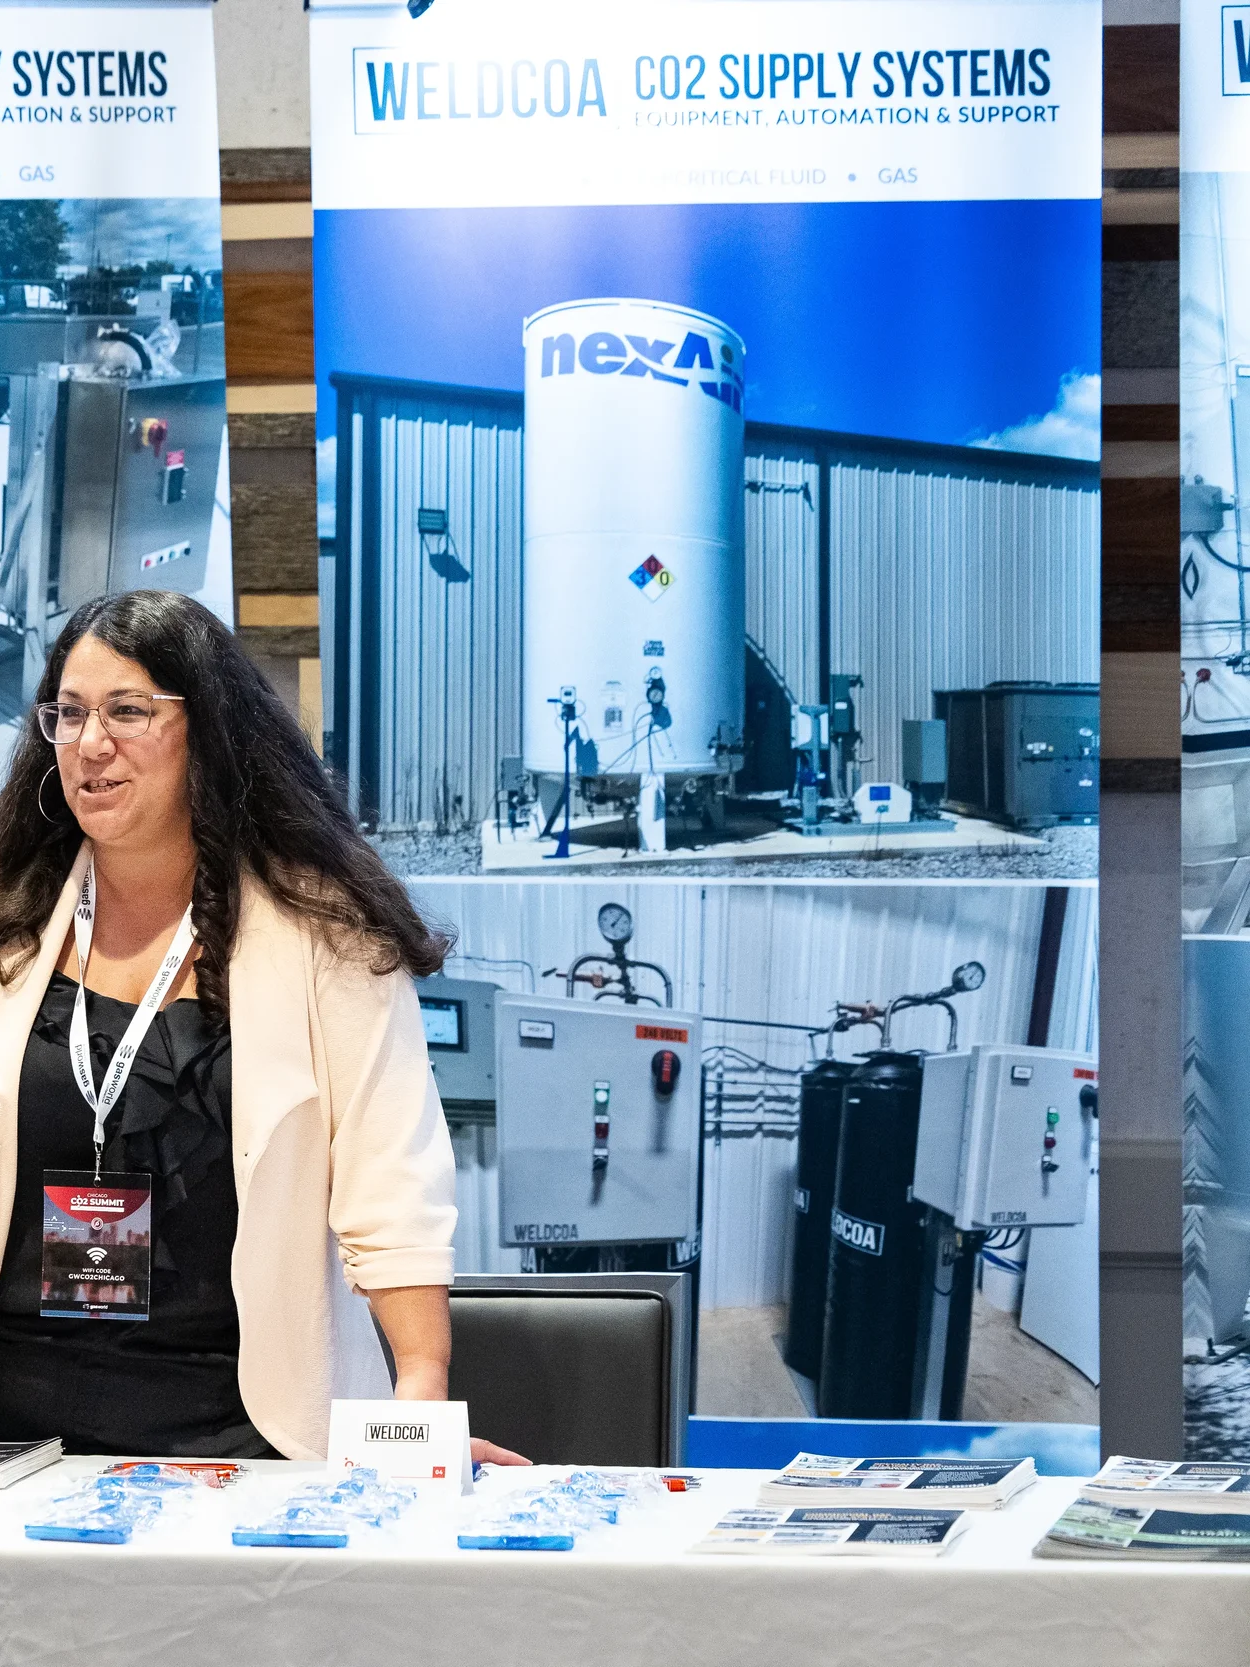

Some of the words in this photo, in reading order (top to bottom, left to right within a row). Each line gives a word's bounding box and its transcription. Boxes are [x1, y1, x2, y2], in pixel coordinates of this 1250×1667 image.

[13, 50, 168, 98] SYSTEMS
[635, 54, 706, 100] CO2
[719, 52, 862, 100] SUPPLY
[873, 48, 1051, 98] SYSTEMS
[365, 58, 608, 121] WELDCOA
[70, 107, 82, 124] &
[89, 106, 178, 124] SUPPORT
[776, 107, 929, 126] AUTOMATION
[937, 106, 951, 124] &
[958, 105, 1060, 124] SUPPORT
[19, 166, 55, 183] GAS
[769, 169, 826, 185] FLUID
[878, 168, 918, 184] GAS
[659, 571, 670, 586] 0
[103, 1061, 126, 1106] gasworld
[89, 1198, 125, 1207] SUMMIT
[513, 1223, 579, 1241] WELDCOA
[68, 1273, 125, 1281] GWCO2CHICAGO
[370, 1425, 425, 1440] WELDCOA
